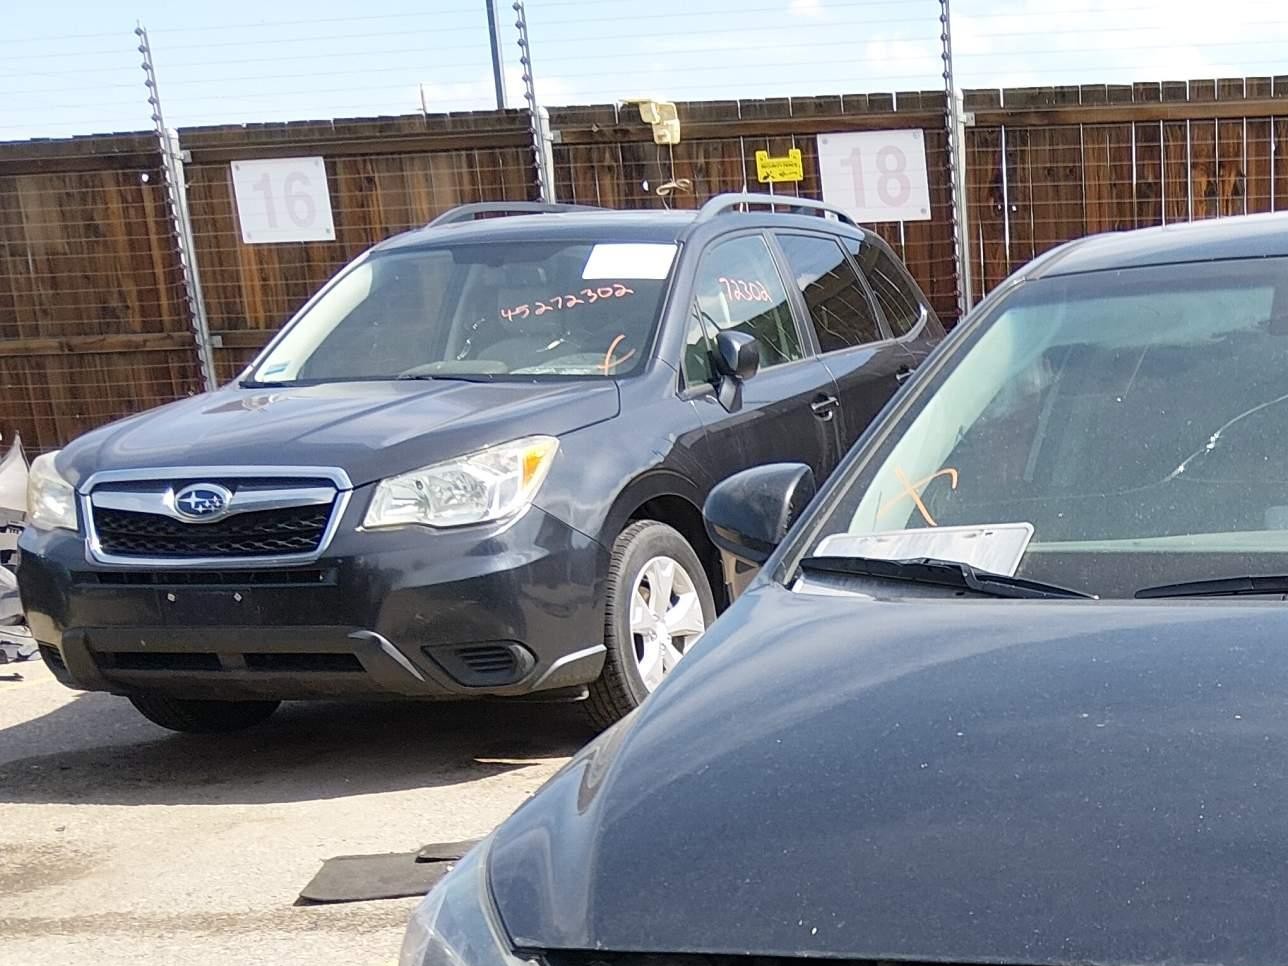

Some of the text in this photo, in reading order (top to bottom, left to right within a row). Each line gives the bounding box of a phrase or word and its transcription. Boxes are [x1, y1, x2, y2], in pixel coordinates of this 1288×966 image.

[252, 171, 317, 230] 16
[839, 145, 911, 210] 18
[500, 283, 635, 322] 45272302
[719, 277, 774, 304] 72302
